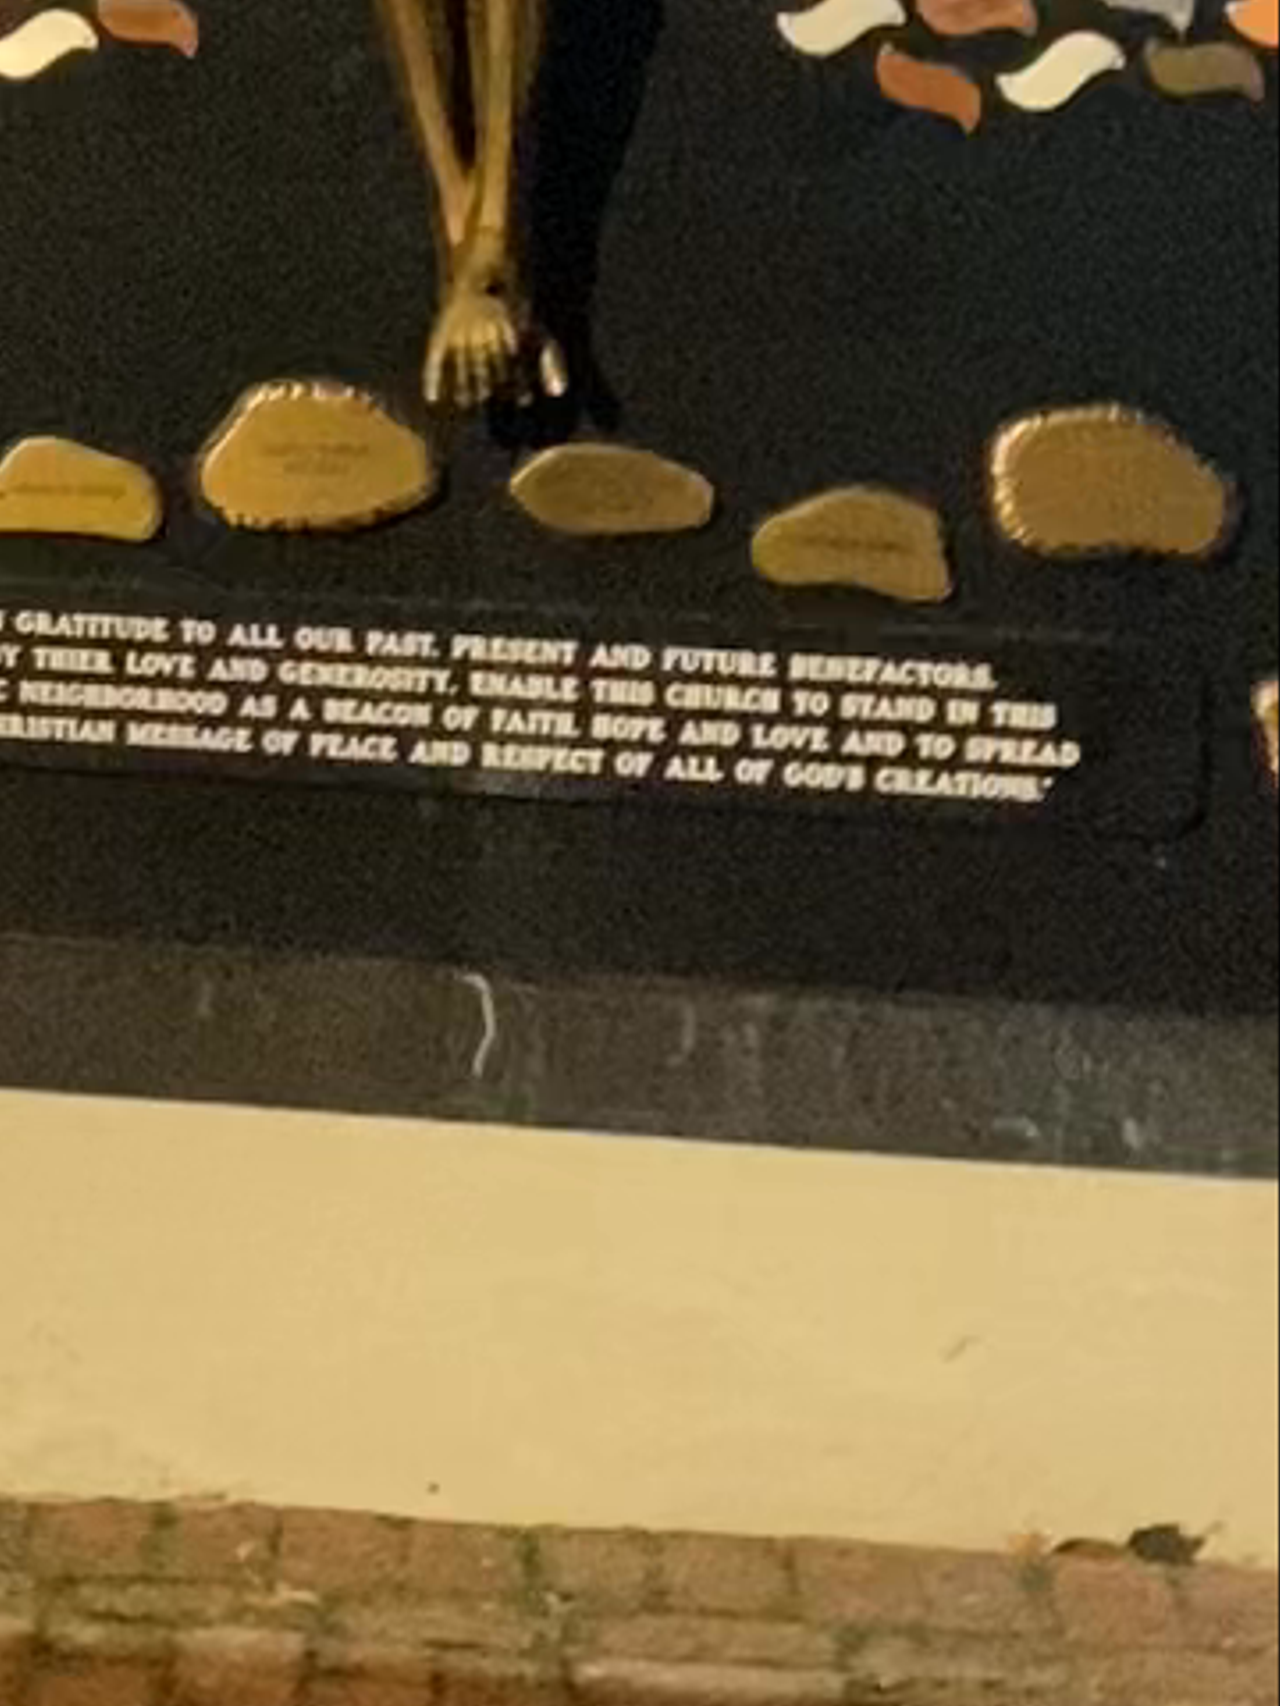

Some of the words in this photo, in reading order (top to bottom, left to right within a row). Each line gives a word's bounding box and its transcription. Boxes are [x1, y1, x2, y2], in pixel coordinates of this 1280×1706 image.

[14, 610, 169, 643] GRATITUDE
[180, 619, 216, 644] TO
[228, 623, 284, 649] ALL
[295, 627, 354, 653] OUR
[451, 635, 579, 666] PRESENT
[590, 643, 650, 669] AND
[662, 647, 777, 677] FUTURE
[19, 680, 228, 715] NEIGHBORHOOD
[239, 694, 277, 719] AS
[289, 698, 313, 721] A
[322, 698, 432, 727] BEACON
[442, 705, 480, 731] OF
[592, 713, 667, 743] HOPE
[679, 720, 739, 746] AND
[751, 723, 830, 752] LOVE
[841, 729, 906, 757] AND
[915, 734, 955, 760] TO
[965, 735, 1081, 768] SPREAD
[126, 651, 195, 679] LOVE
[207, 658, 268, 683] AND
[278, 660, 459, 695] GENEROSITY,
[470, 670, 579, 702] ENABLE
[591, 679, 654, 707] THIS
[665, 683, 780, 714] CHURCH
[792, 691, 830, 716] TO
[840, 693, 936, 723] STAND
[947, 699, 979, 725] IN
[991, 701, 1056, 730] THIS
[126, 721, 253, 753] MESSAGE
[261, 730, 300, 755] OF
[310, 734, 397, 763] PEACE
[409, 741, 471, 767] AND
[481, 742, 605, 774] RESPECT
[614, 751, 654, 776] OF
[665, 755, 724, 782] ALL
[734, 758, 773, 783] OF
